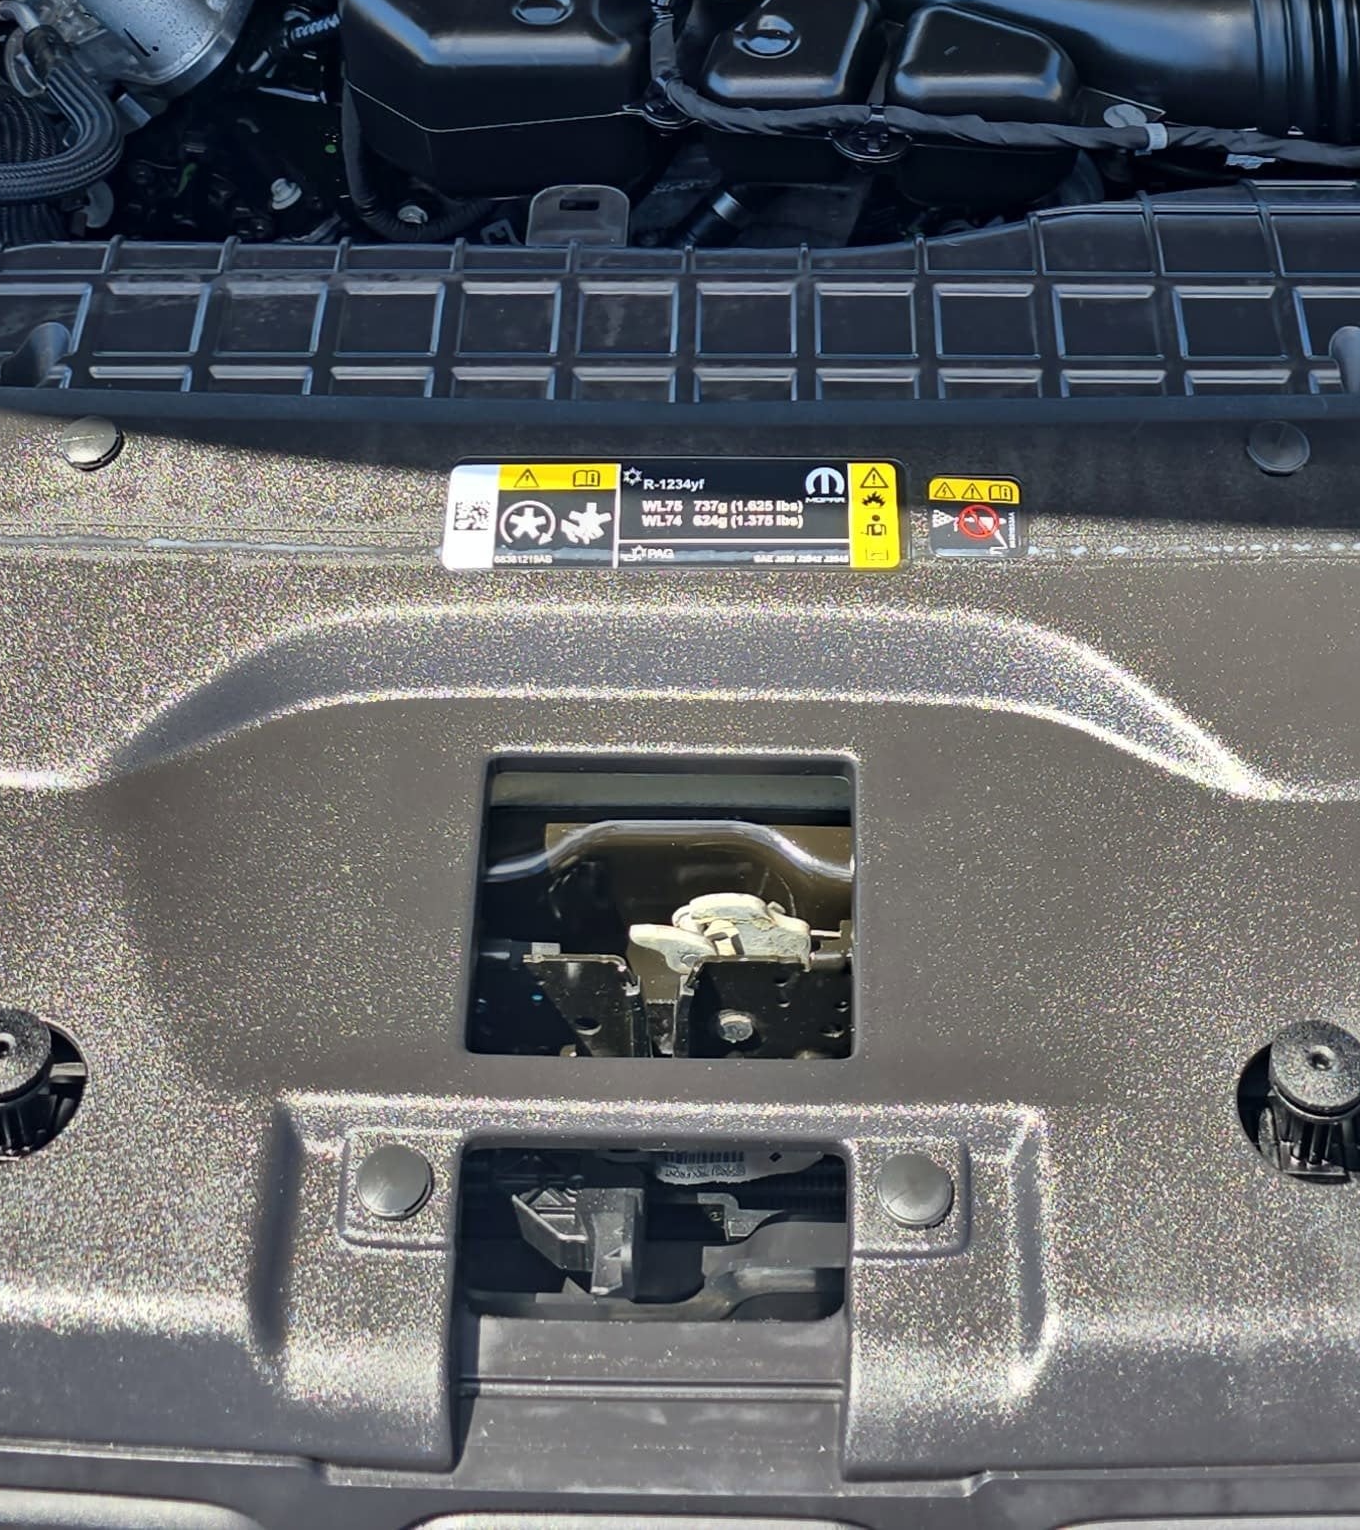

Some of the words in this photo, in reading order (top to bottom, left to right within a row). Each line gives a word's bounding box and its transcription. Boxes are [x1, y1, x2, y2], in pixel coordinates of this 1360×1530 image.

[643, 478, 705, 492] R-1234yf
[642, 500, 683, 512] WL75
[693, 500, 728, 514] 737g
[731, 500, 774, 514] (1.625
[776, 500, 804, 514] lbs)
[641, 514, 683, 527] WL74
[692, 514, 728, 529] 624g
[730, 514, 774, 529] (1.375
[776, 514, 804, 529] lbs)
[648, 548, 675, 560] PAG
